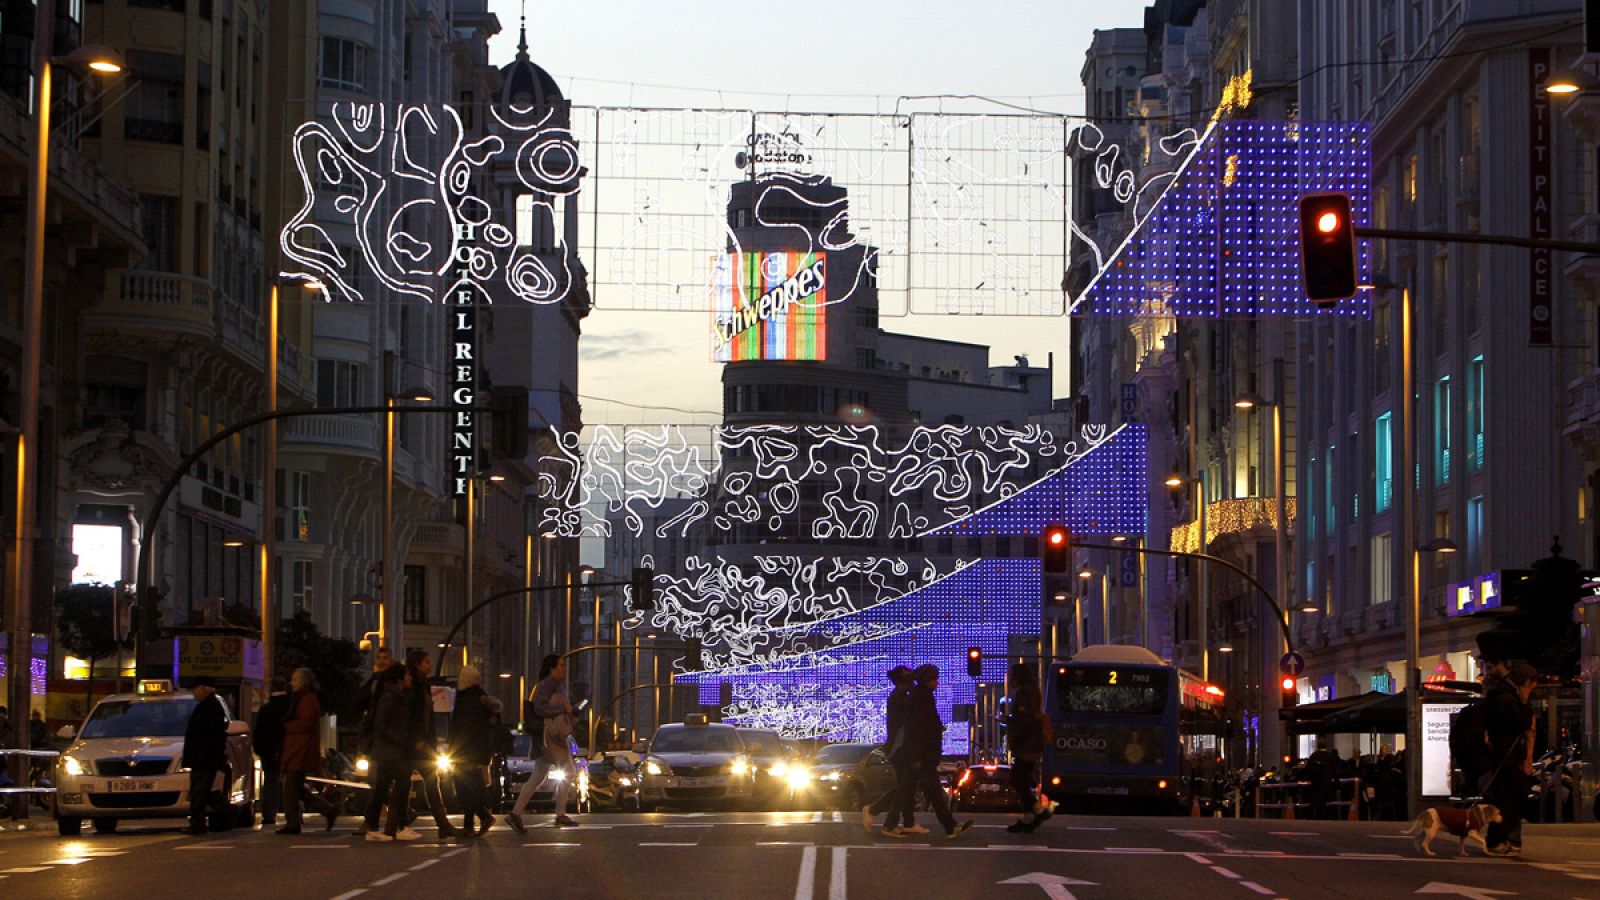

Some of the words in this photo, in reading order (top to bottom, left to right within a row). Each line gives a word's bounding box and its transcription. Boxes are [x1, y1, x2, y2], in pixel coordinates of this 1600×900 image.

[1533, 63, 1547, 162] PETIT
[455, 223, 475, 331] HOTEL
[714, 258, 827, 352] Schweppes
[1108, 671, 1118, 684] 2
[1056, 737, 1107, 750] OCASO
